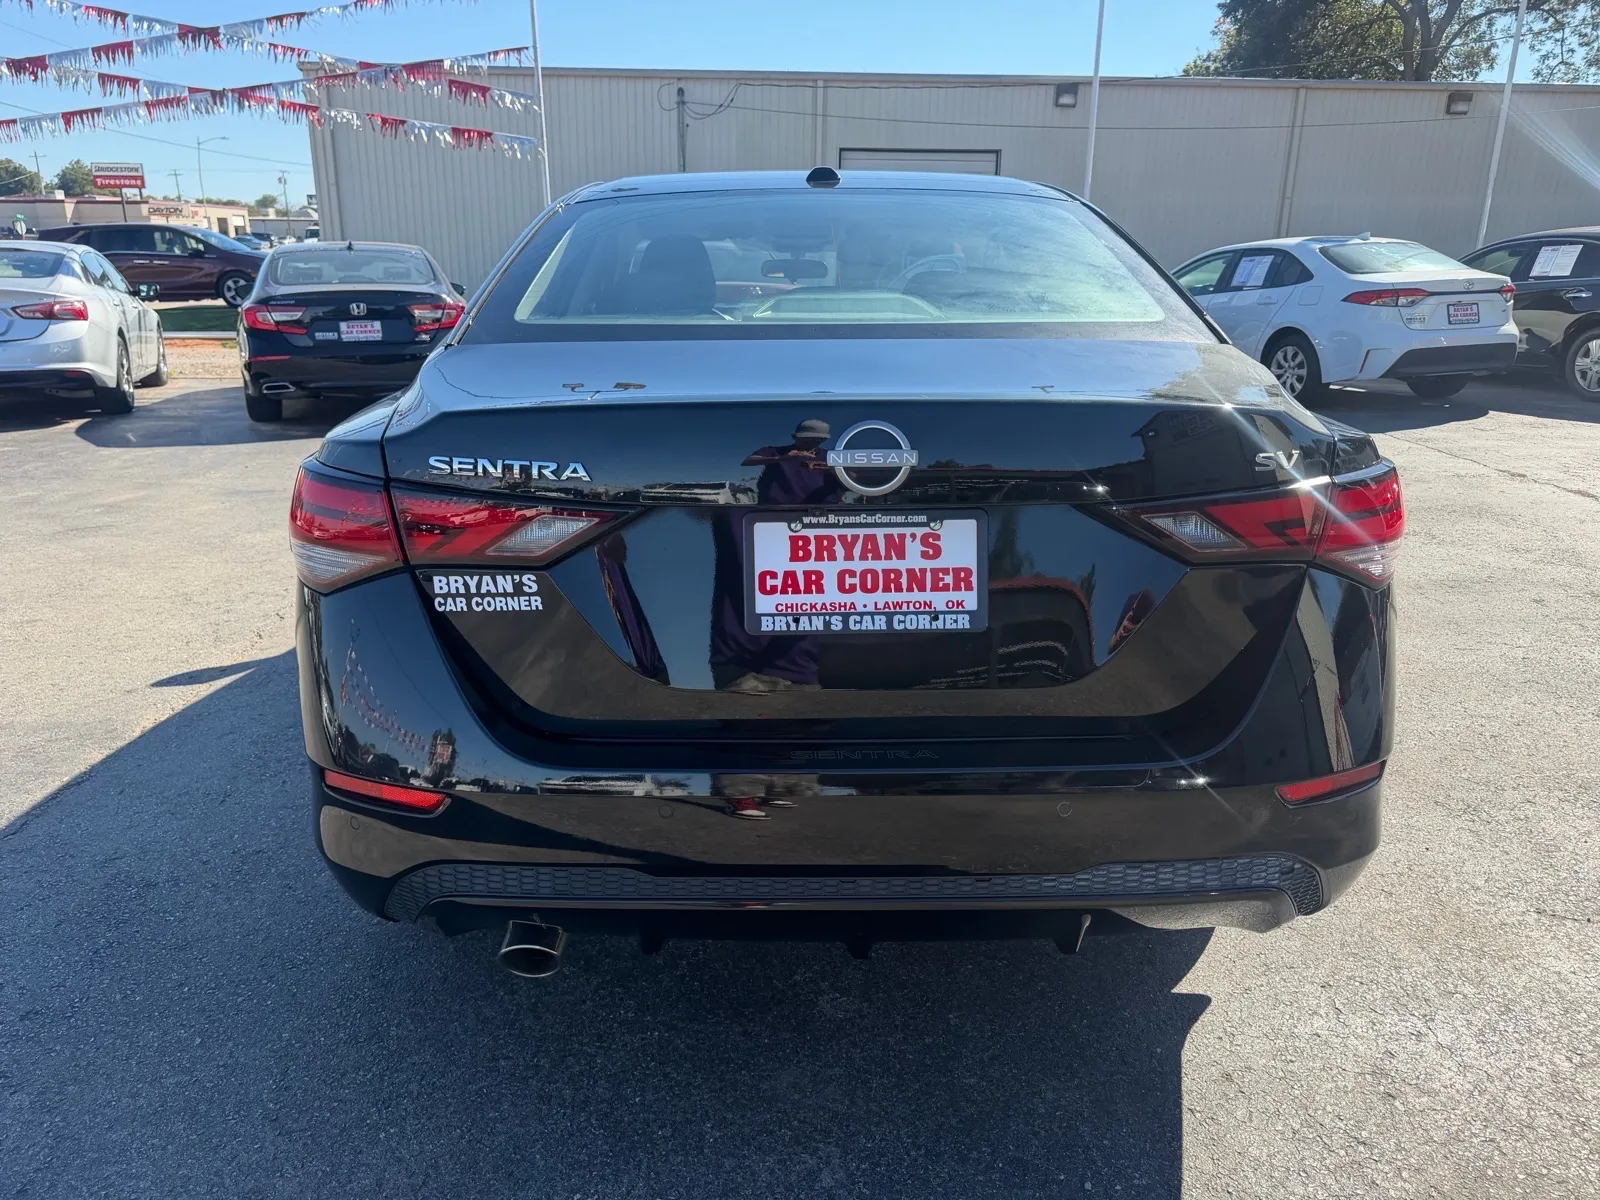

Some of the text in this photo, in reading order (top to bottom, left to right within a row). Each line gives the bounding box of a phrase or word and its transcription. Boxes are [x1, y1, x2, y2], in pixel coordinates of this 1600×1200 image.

[96, 178, 142, 186] Firestone
[830, 452, 916, 464] NISSAN
[1255, 449, 1300, 471] SV
[428, 456, 592, 482] SENTRA
[802, 513, 927, 526] www.BryansCarCorner.com
[788, 532, 942, 562] BRYAN'S
[433, 574, 538, 594] BRYAN'S
[758, 567, 974, 595] CAR CORNER
[434, 596, 543, 612] CAR CORNER
[775, 599, 966, 613] CHICKASHA LAWTON, OK
[761, 614, 970, 631] BRYAN'S CAR CORNER
[790, 750, 940, 759] SENTRA
